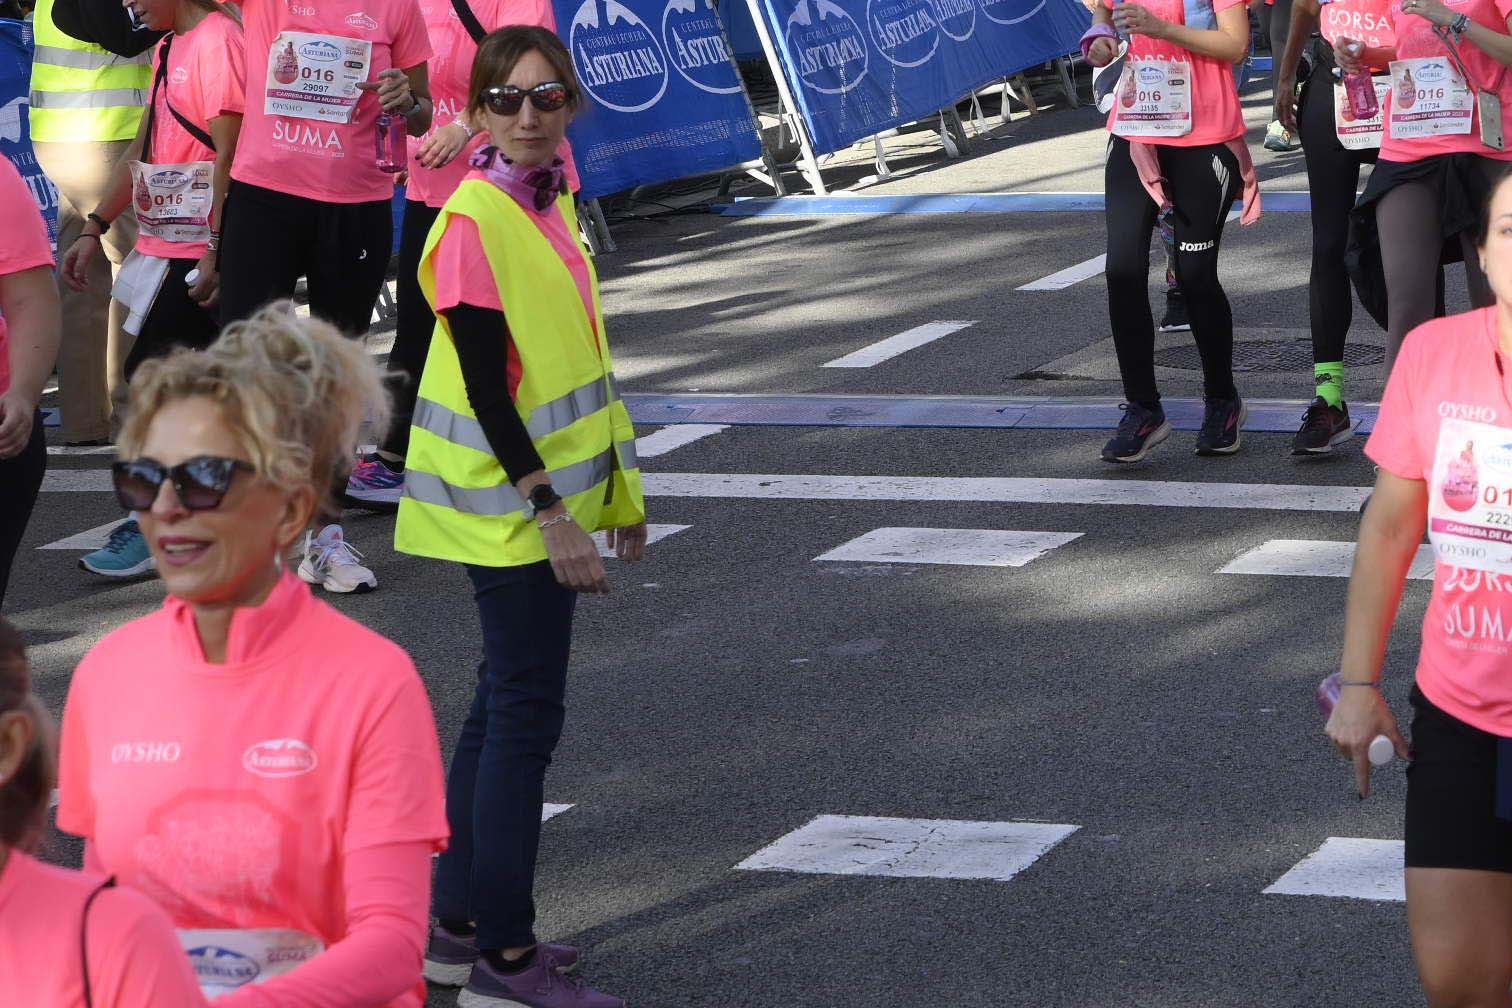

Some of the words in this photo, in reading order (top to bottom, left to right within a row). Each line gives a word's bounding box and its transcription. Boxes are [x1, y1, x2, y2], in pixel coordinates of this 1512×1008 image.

[672, 26, 732, 69] ASTUR
[577, 41, 664, 87] ASTURIANA
[301, 66, 335, 82] 016
[302, 82, 329, 93] 29097
[1417, 88, 1444, 100] 016
[1138, 90, 1161, 102] 016
[272, 102, 303, 112] OYSHO
[1419, 102, 1441, 111] 11734
[272, 119, 342, 150] SUMA
[154, 193, 183, 206] 016
[1437, 400, 1496, 423] OYSHO
[1446, 524, 1488, 540] CARRERA
[1489, 529, 1502, 540] DE
[1439, 542, 1487, 559] OYSHO
